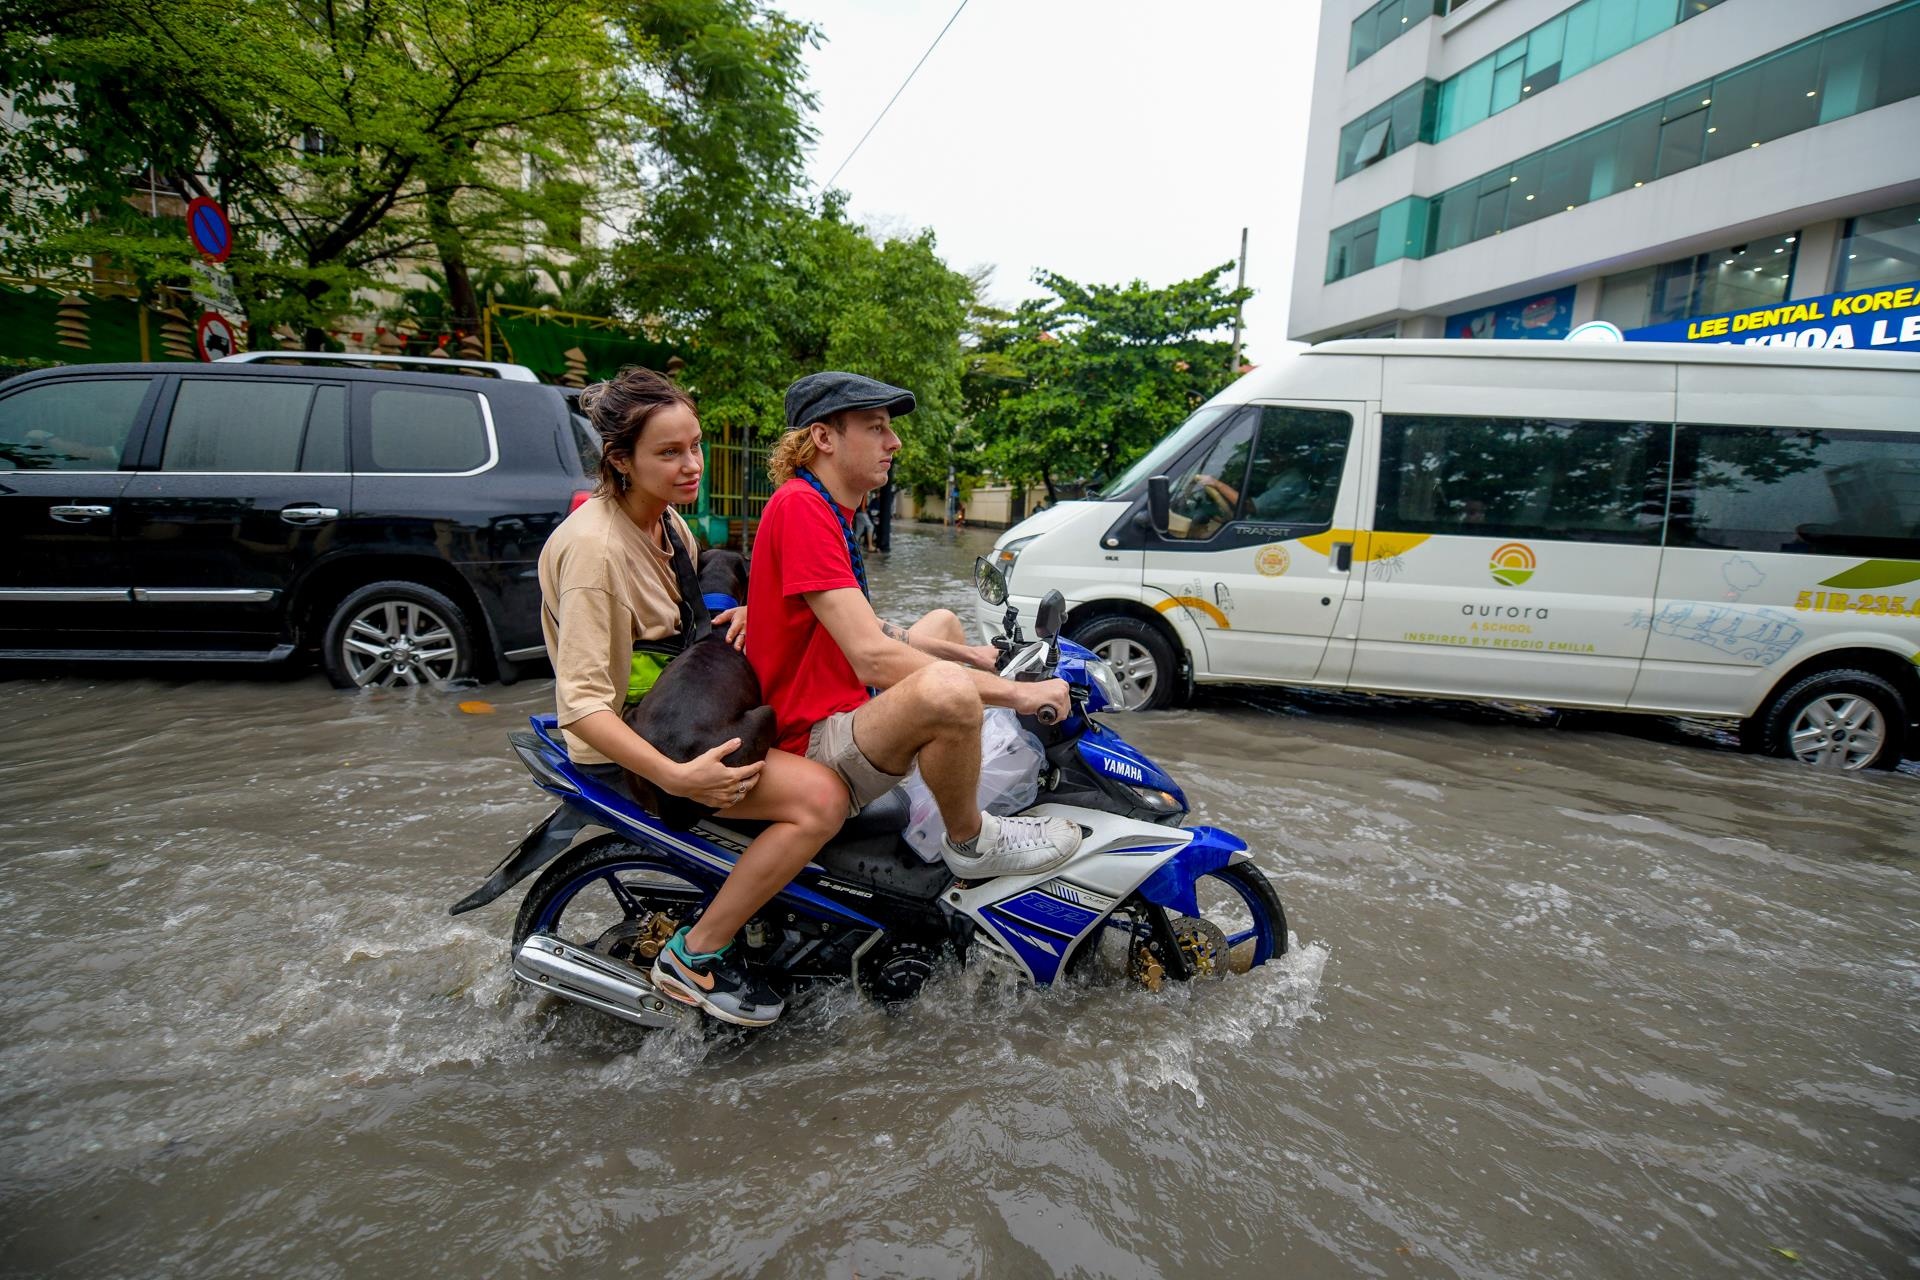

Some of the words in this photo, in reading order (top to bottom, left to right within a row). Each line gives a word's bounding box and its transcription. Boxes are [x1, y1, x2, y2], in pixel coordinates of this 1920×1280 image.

[1687, 317, 1730, 340] LEE
[1732, 302, 1825, 333] DENTAL
[1234, 525, 1291, 537] TRANSIT
[1461, 603, 1549, 620] aurora
[1470, 621, 1479, 632] A
[1482, 622, 1533, 634] SCHOOL
[1403, 632, 1468, 645] INSPIRED
[1471, 636, 1489, 648] BY
[1493, 638, 1544, 650] REGGIO
[1547, 641, 1596, 653] EMILIA
[1103, 757, 1143, 782] YAMAHA
